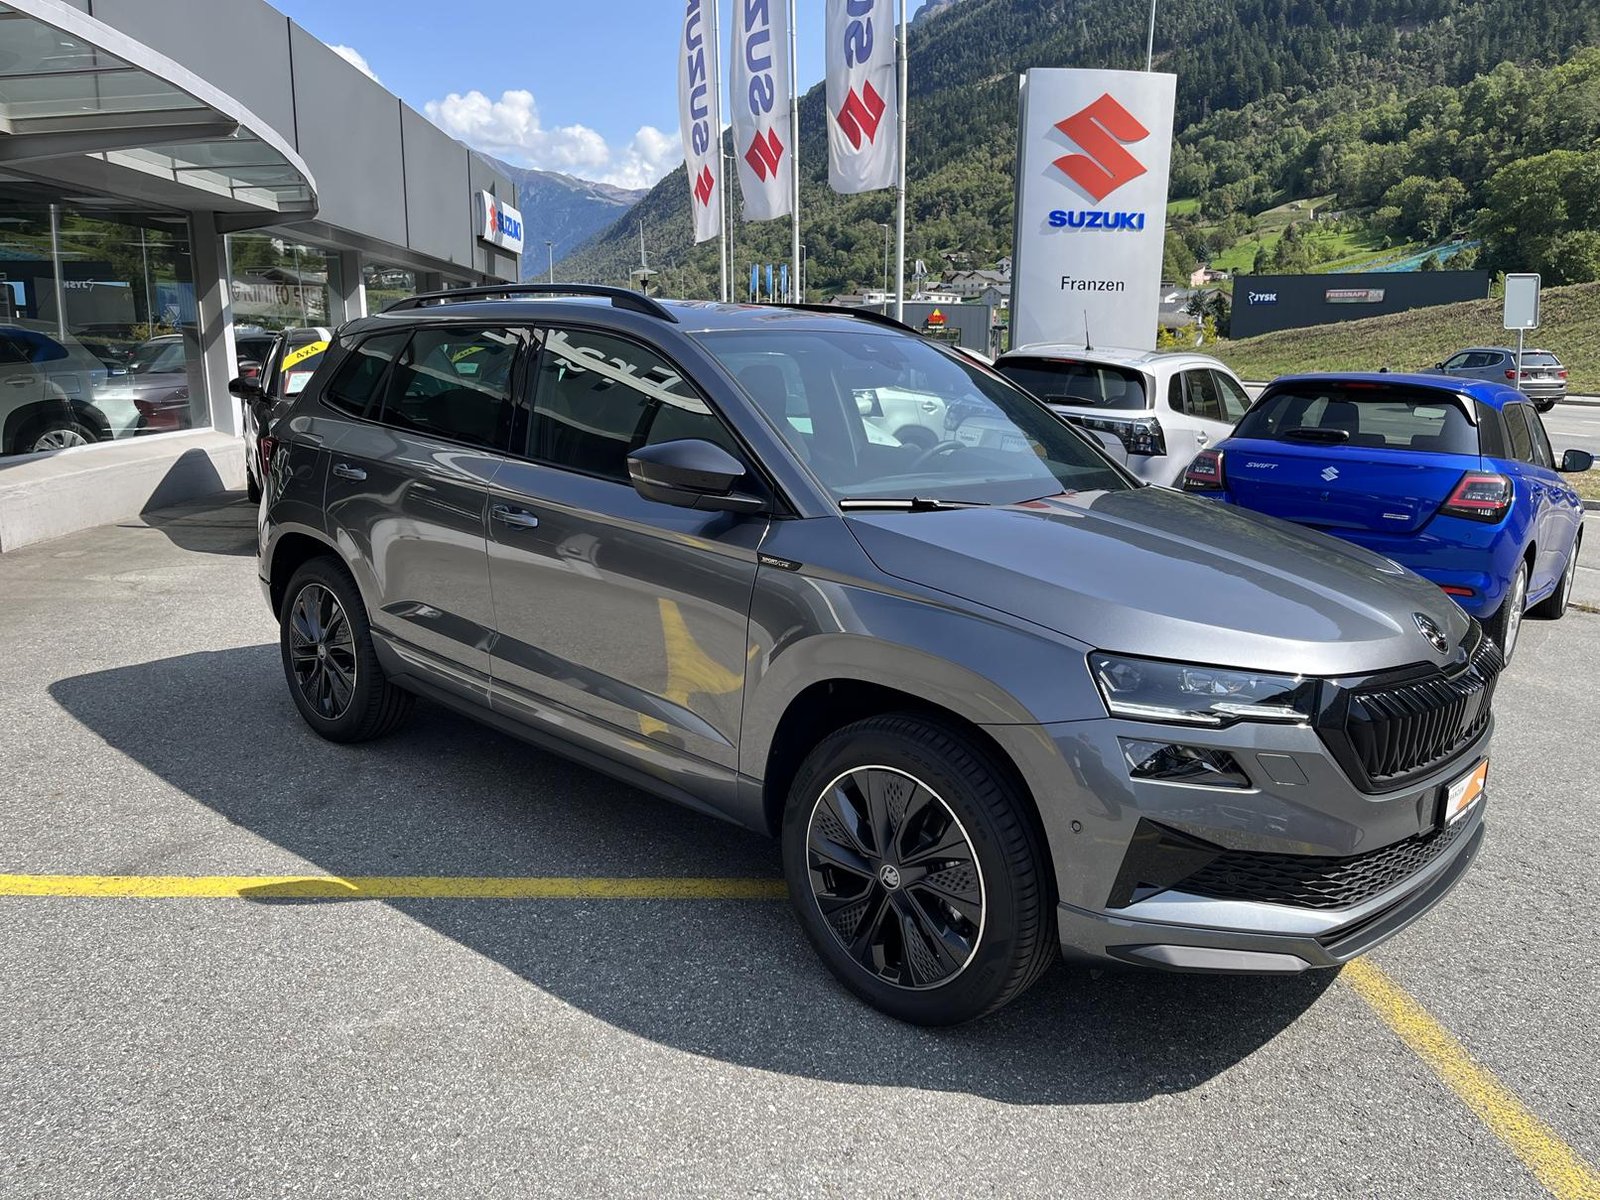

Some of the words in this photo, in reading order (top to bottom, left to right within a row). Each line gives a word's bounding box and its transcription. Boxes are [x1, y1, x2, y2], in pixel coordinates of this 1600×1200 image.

[497, 210, 521, 241] SUZUKI
[1048, 210, 1145, 230] SUZUKI
[1061, 276, 1125, 291] Franzen
[1253, 293, 1277, 301] JYSK
[1245, 461, 1278, 470] SWIFT
